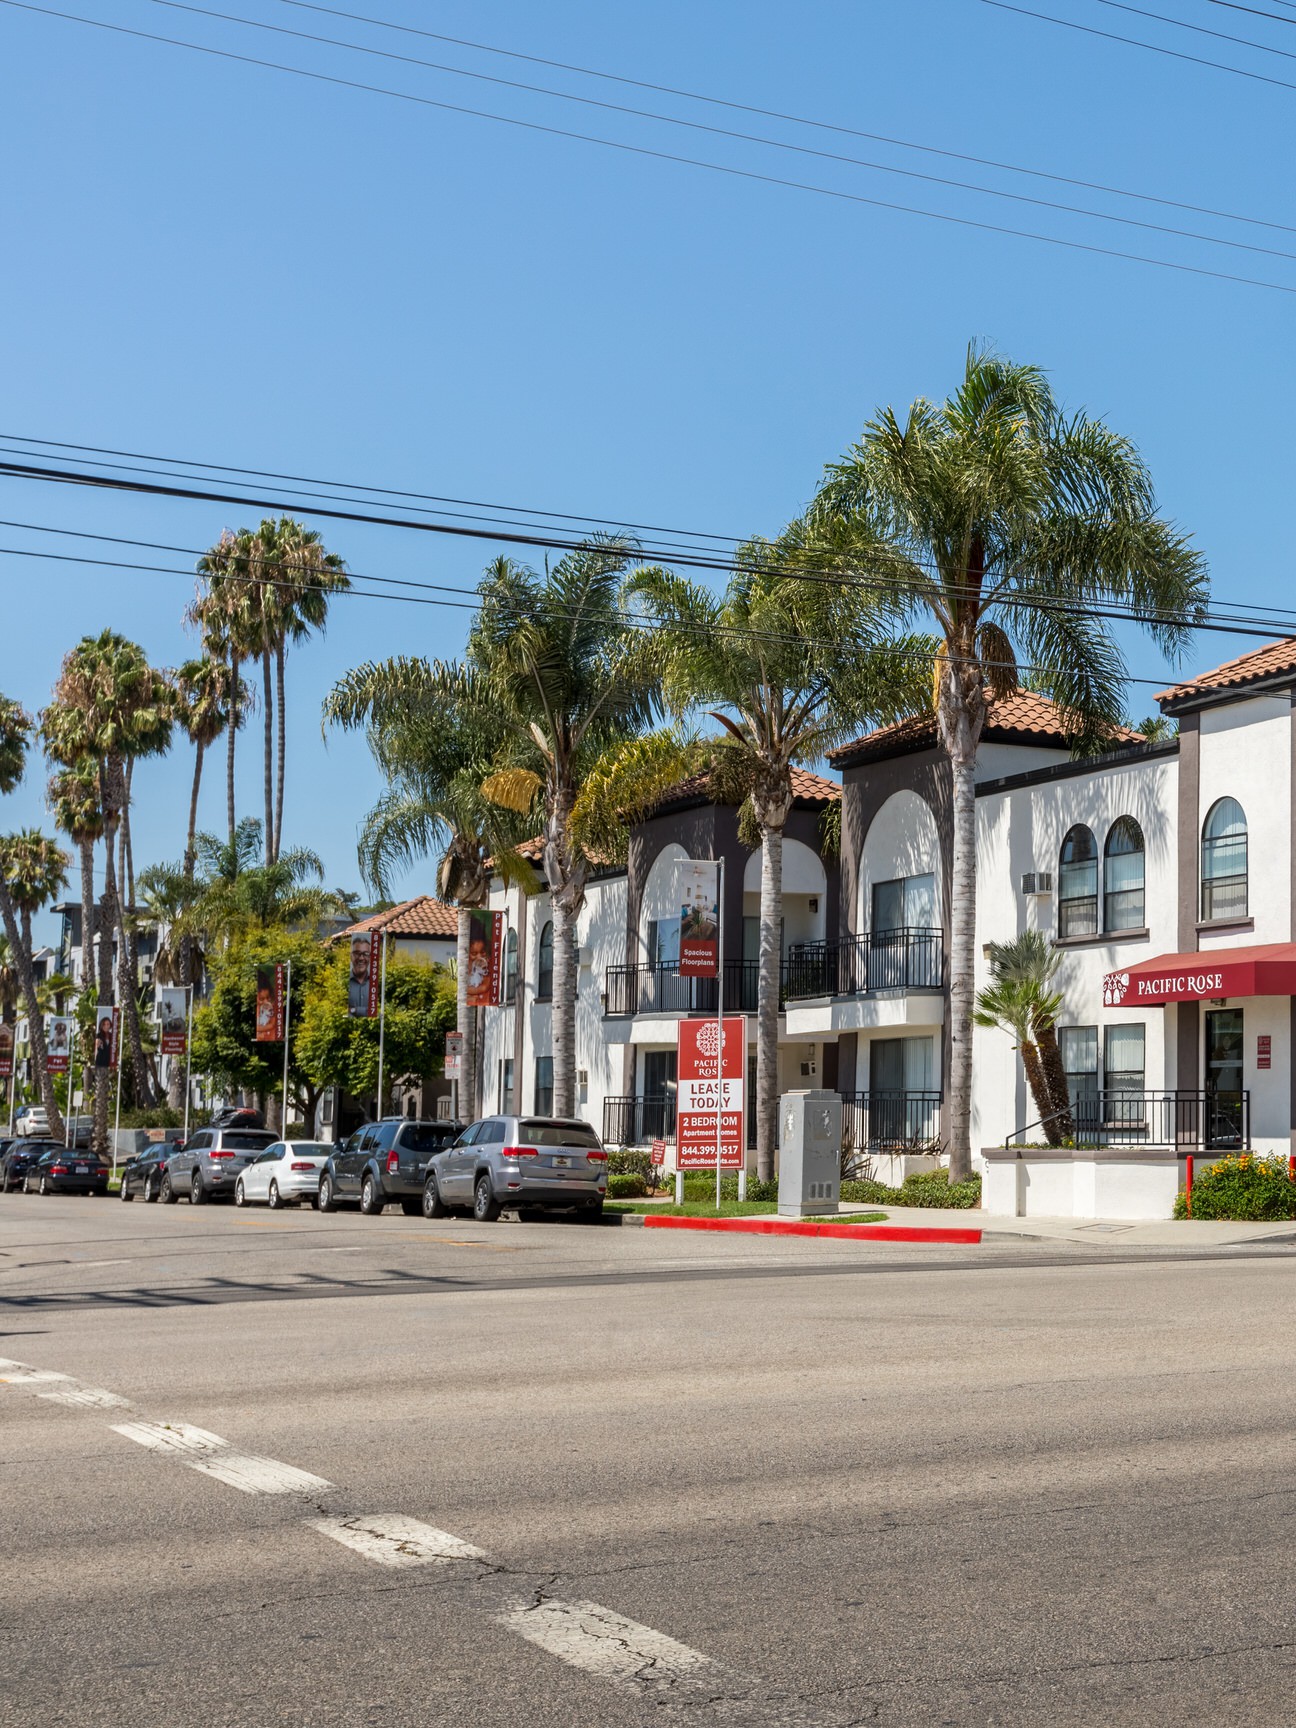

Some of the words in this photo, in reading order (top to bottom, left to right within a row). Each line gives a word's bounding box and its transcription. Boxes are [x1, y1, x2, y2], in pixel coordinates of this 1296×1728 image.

[684, 949, 713, 957] Spacious
[681, 958, 715, 967] Floorplans
[492, 942, 500, 1003] Friendly
[1138, 977, 1185, 995] PACIFIC
[1187, 974, 1223, 994] ROSE
[694, 1059, 728, 1068] PACIFC
[691, 1083, 730, 1095] LEASE
[689, 1096, 731, 1109] TODAY
[682, 1116, 689, 1127] 2
[682, 1129, 716, 1138] Apartment
